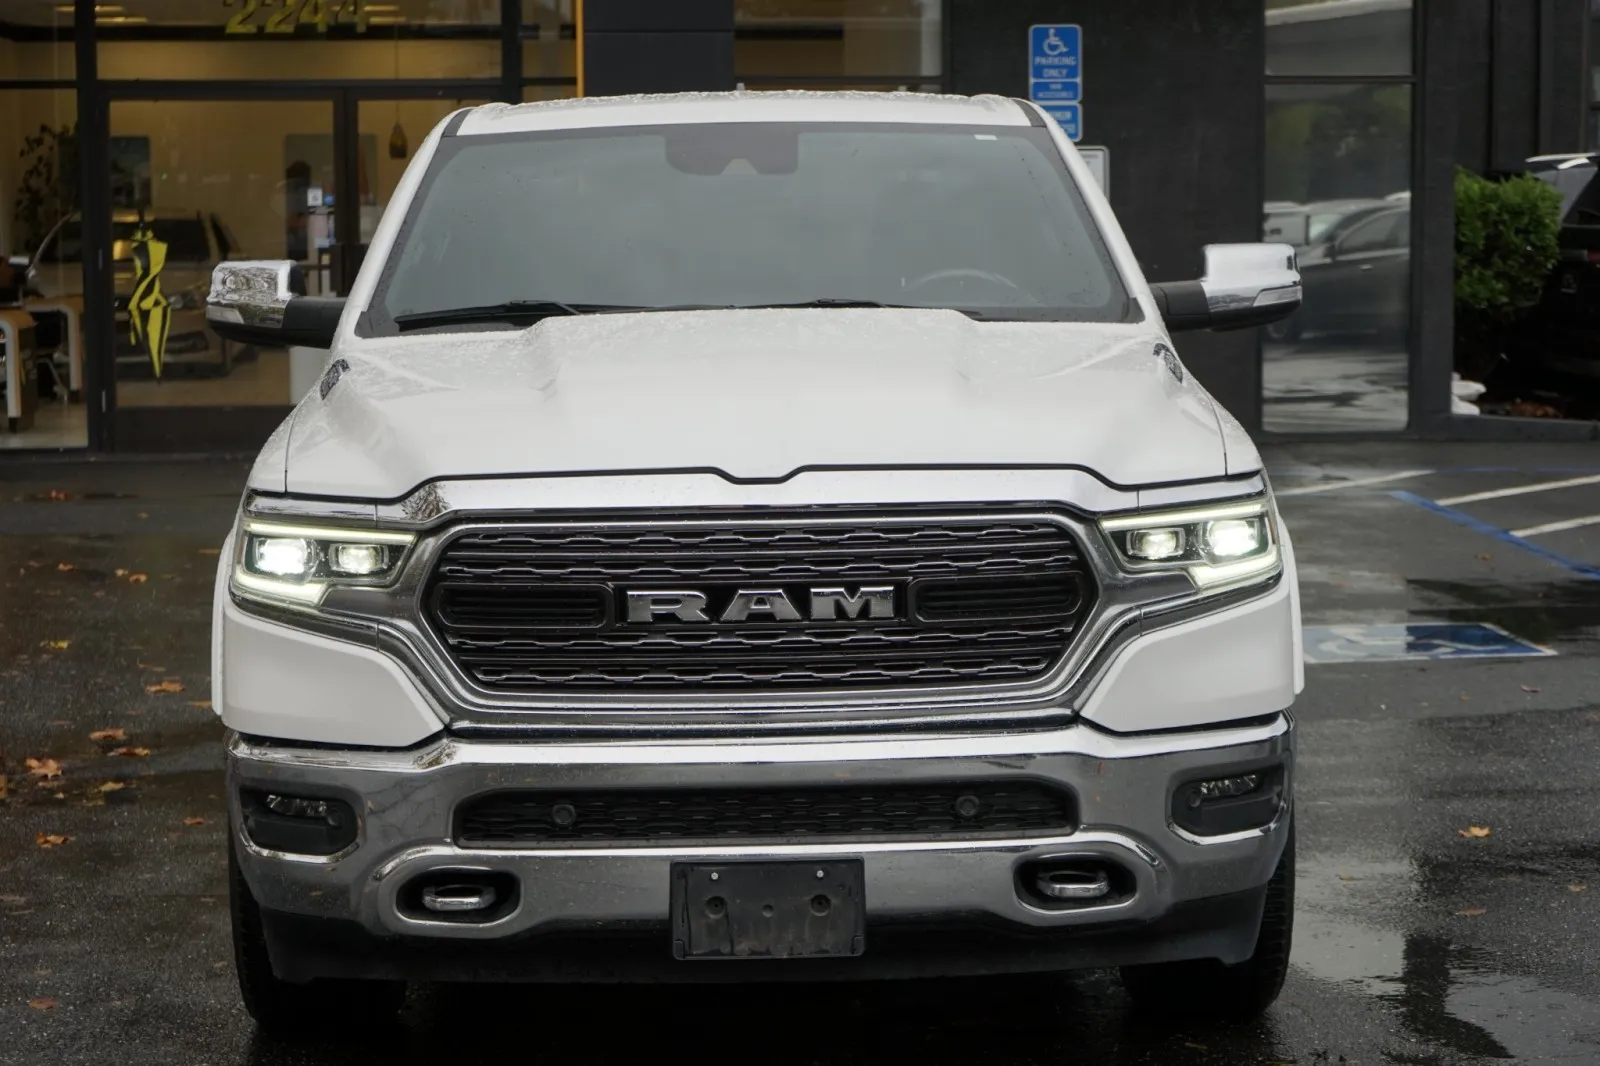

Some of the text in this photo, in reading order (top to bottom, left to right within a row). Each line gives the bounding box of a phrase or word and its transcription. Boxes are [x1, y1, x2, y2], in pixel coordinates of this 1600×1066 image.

[222, 0, 368, 34] 2244
[1034, 56, 1077, 66] PARKING
[1042, 68, 1068, 78] ONLY
[626, 586, 895, 623] RAM
